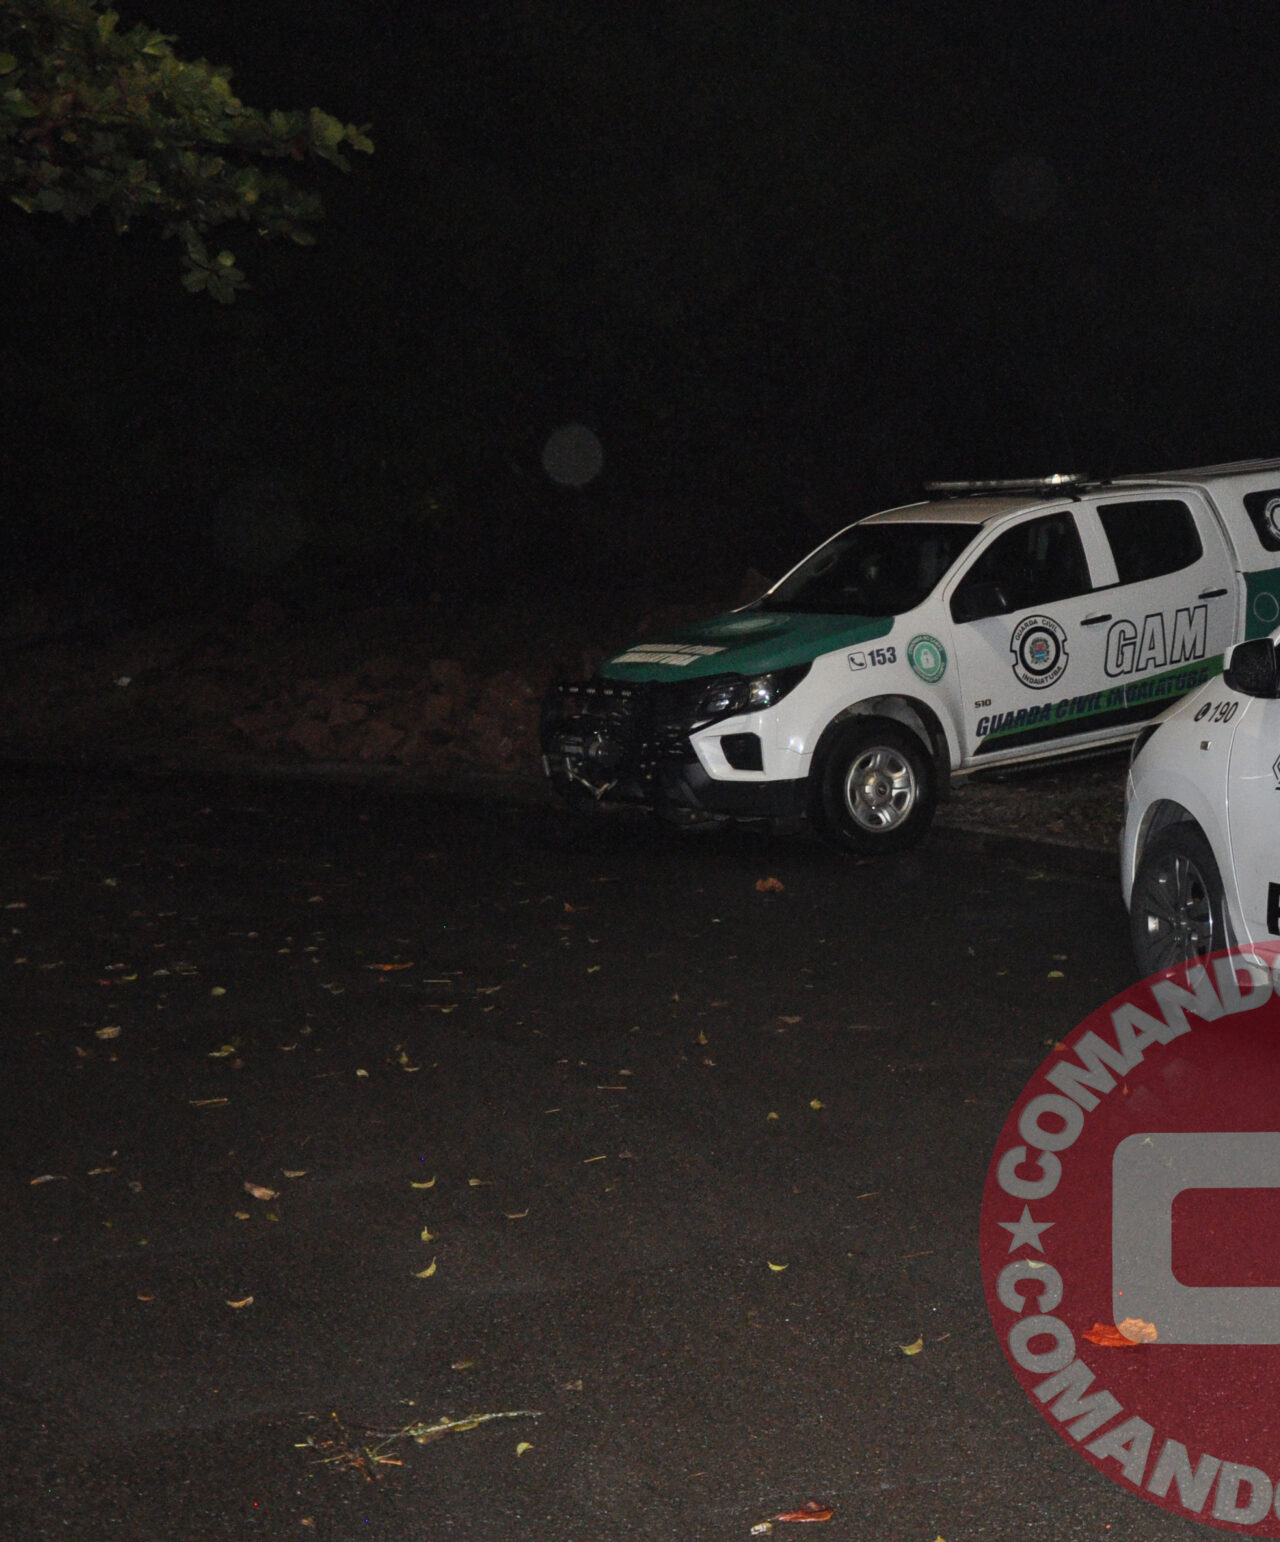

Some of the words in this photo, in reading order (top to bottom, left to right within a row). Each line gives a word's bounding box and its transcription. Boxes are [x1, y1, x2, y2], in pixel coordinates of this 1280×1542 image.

[1015, 618, 1039, 641] GUARDA
[1041, 618, 1058, 633] CIVIL
[1104, 604, 1209, 679] GAM
[868, 646, 897, 667] 153
[1021, 665, 1063, 685] INDAIATUBA
[974, 698, 993, 709] S10
[1210, 701, 1239, 723] 190
[976, 703, 1052, 737] GUARDA
[1055, 694, 1102, 719] CIVIL
